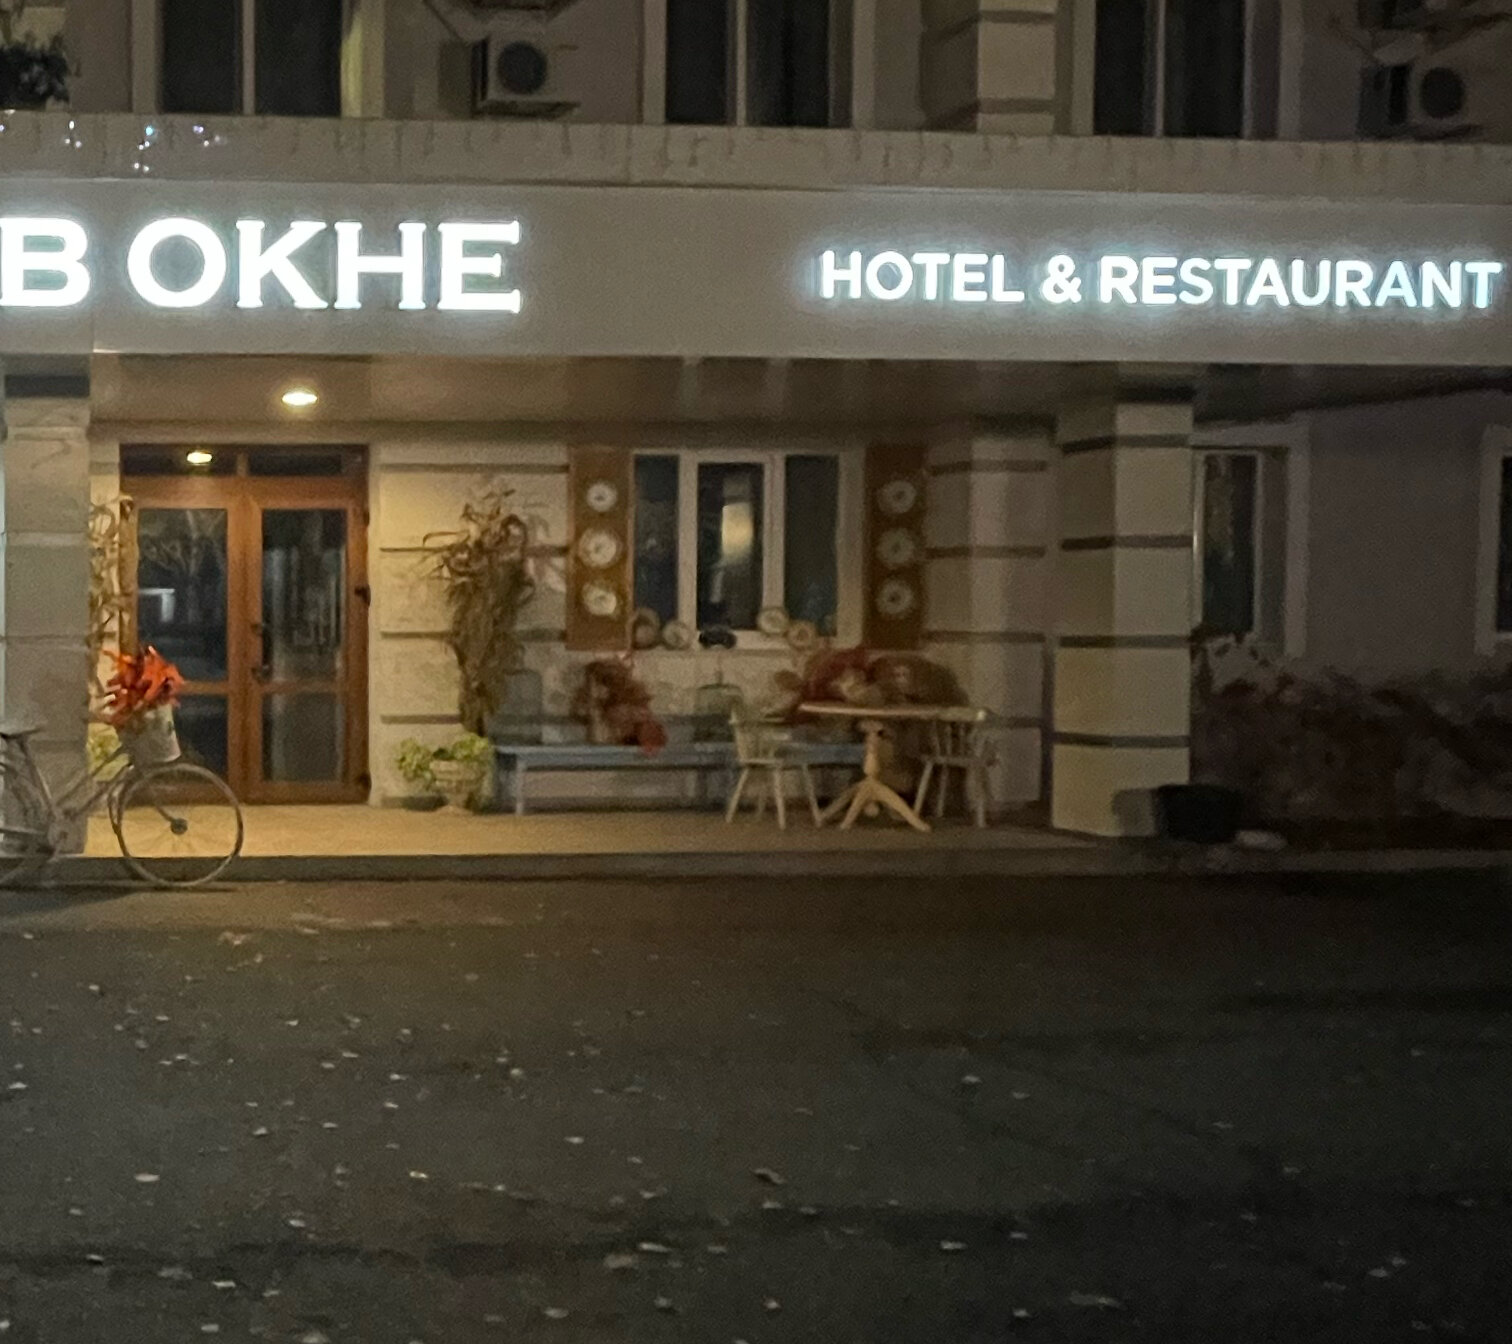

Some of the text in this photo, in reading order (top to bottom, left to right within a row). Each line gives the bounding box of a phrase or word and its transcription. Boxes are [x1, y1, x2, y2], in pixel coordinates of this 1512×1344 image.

[127, 216, 522, 314] ОКНЕ
[820, 250, 1503, 309] HOTEL & RESTAURANT
